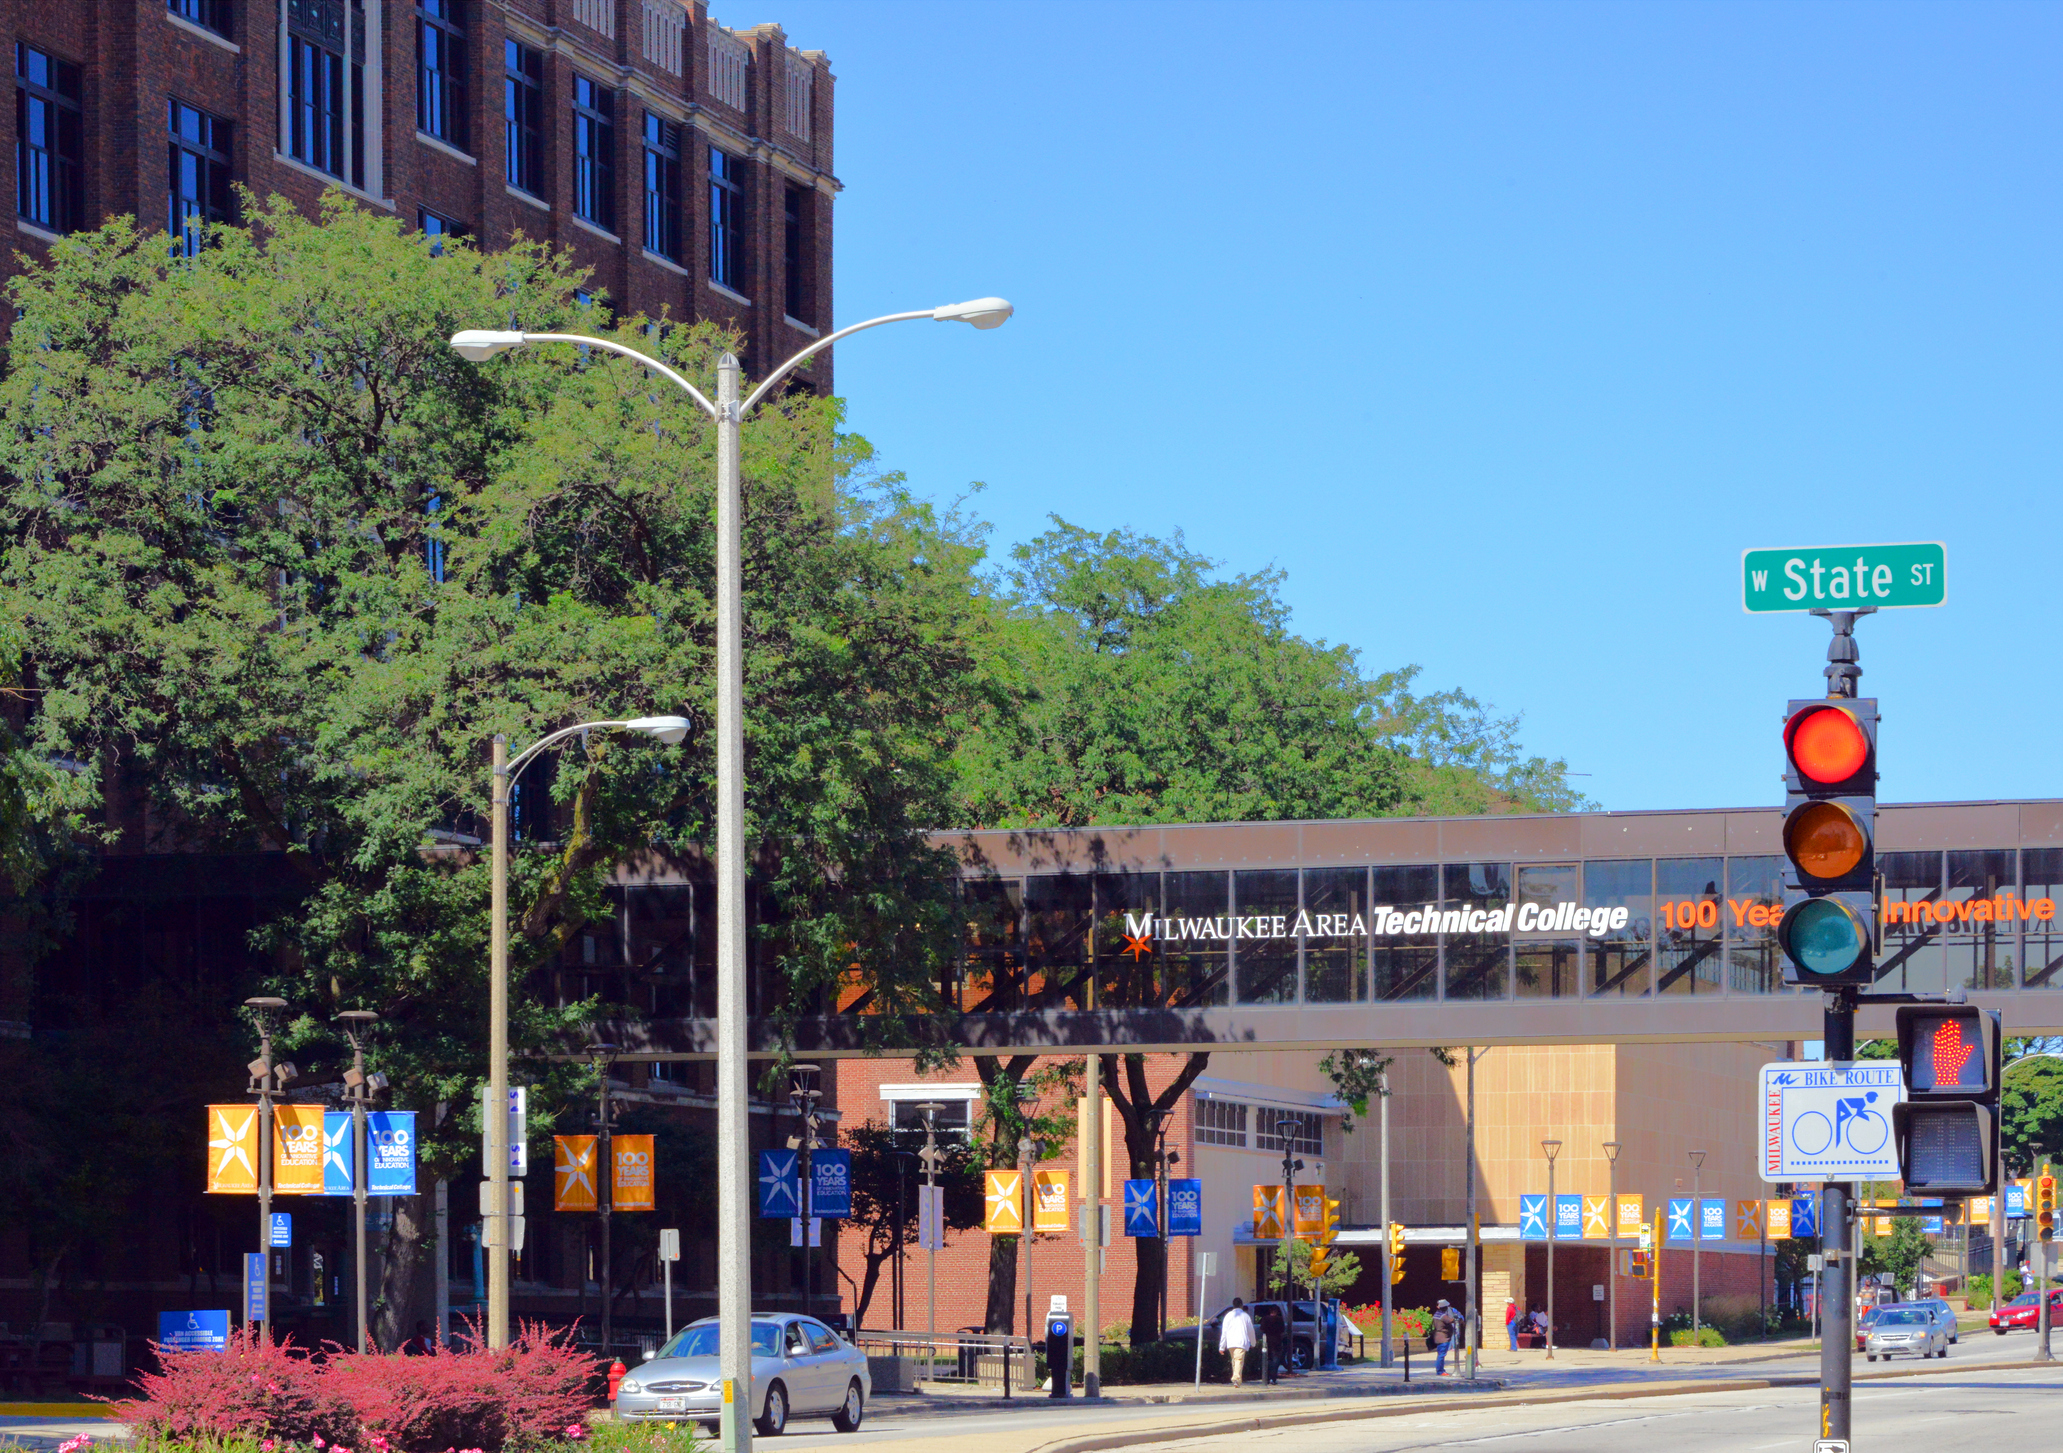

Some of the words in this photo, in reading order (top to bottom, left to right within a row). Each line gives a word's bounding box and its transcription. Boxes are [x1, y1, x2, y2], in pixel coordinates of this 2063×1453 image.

[1752, 570, 1768, 592] W
[1783, 557, 1893, 600] State
[1910, 563, 1934, 585] ST
[1660, 900, 1717, 929] 100
[1727, 898, 1786, 927] Yea
[1883, 893, 2056, 923] Innovative
[1123, 912, 1286, 941] MILWAUKEE
[1291, 909, 1367, 938] AREA
[1373, 902, 1515, 934] Technical
[1516, 901, 1628, 938] College
[1805, 1071, 1838, 1086] BIKE
[1845, 1070, 1894, 1085] ROUTE
[281, 1125, 318, 1140] 100
[1768, 1089, 1781, 1172] MILWAUKEE
[373, 1130, 409, 1145] 100
[281, 1141, 318, 1153] YEARS
[374, 1145, 409, 1157] YEARS
[616, 1152, 649, 1165] 100
[617, 1166, 649, 1176] YEARS
[816, 1163, 846, 1176] 100
[816, 1177, 846, 1186] YEARS
[1038, 1183, 1065, 1195] 100
[1039, 1195, 1066, 1204] YEARS
[1171, 1191, 1198, 1201] 100
[1298, 1196, 1322, 1206] 100
[1171, 1202, 1198, 1210] YEARS
[1299, 1206, 1322, 1214] YEARS
[1558, 1204, 1579, 1212] 100
[1620, 1204, 1640, 1212] 100
[1703, 1207, 1722, 1215] 100
[1769, 1208, 1788, 1216] 100
[1056, 1324, 1063, 1334] P
